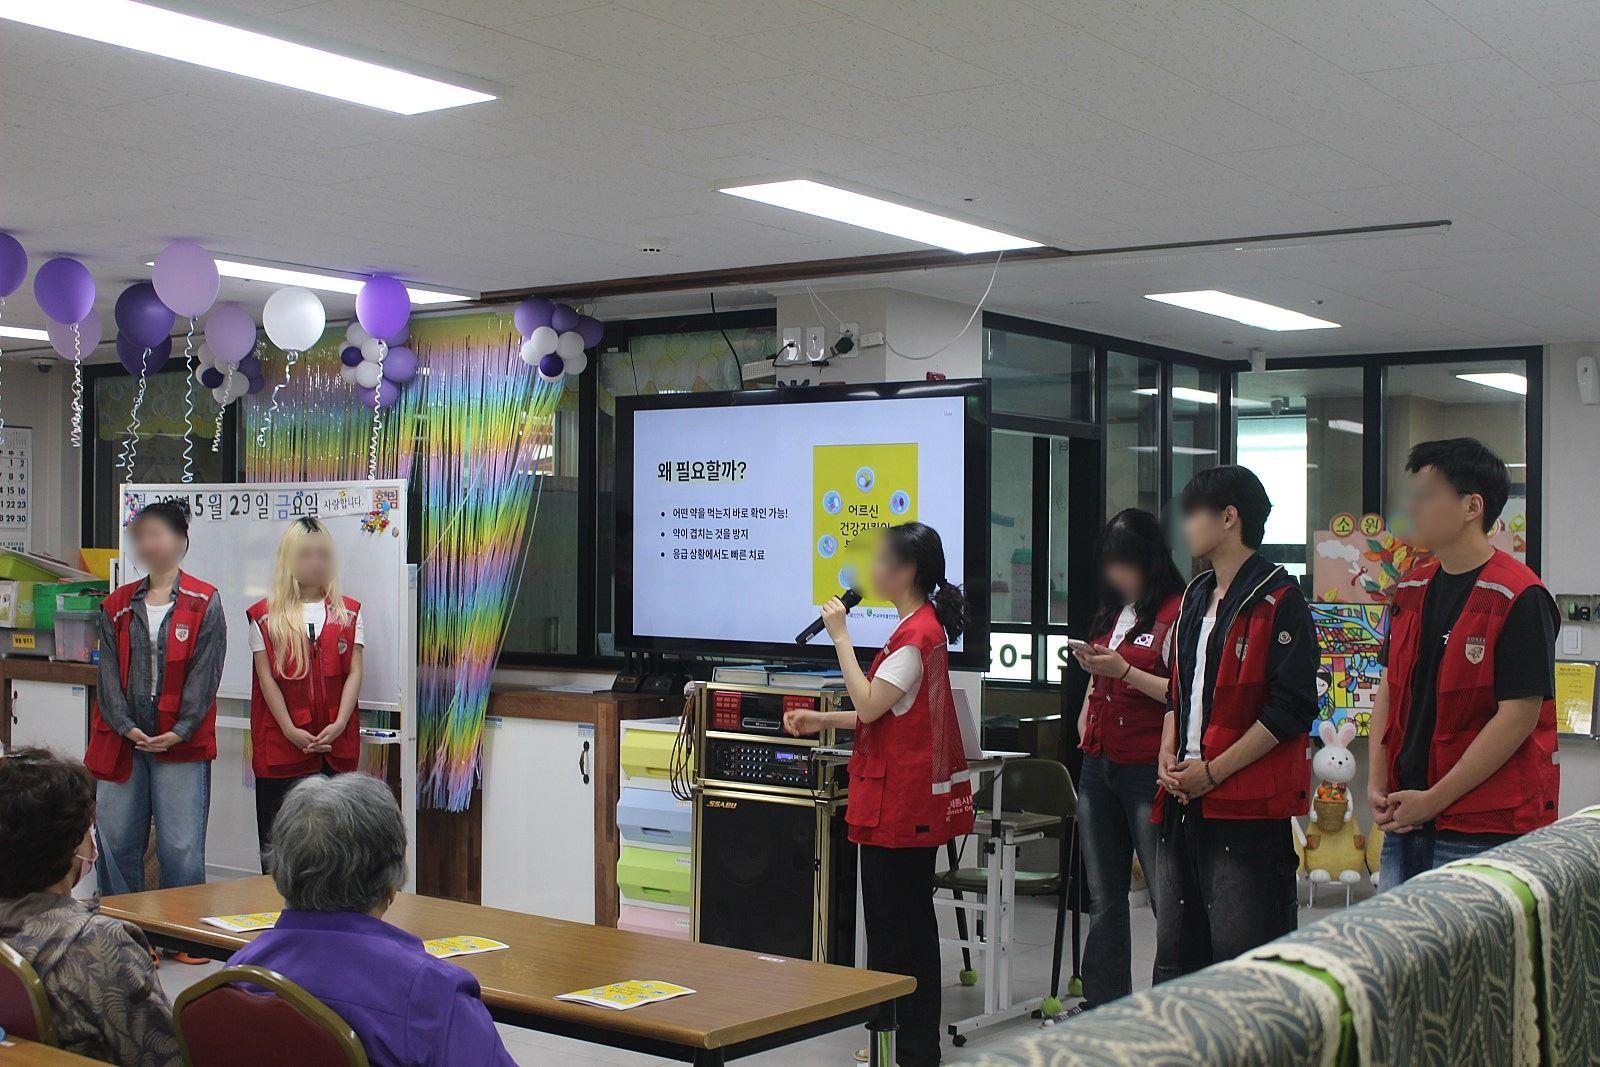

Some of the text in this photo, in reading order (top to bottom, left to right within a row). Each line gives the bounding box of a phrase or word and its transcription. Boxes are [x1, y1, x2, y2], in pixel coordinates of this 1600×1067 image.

[658, 459, 747, 482] 왜 필요할까?
[7, 486, 26, 495] 15 16
[6, 500, 15, 509] 22
[17, 500, 26, 509] 23
[194, 493, 223, 520] 5월
[229, 493, 269, 520] 29일
[274, 491, 319, 520] 금요일
[323, 496, 364, 511] 사랑합니다.
[6, 514, 15, 523] 29
[16, 514, 26, 523] 30
[672, 507, 788, 520] 어떤 약을 먹는지 바로 확인 가능!
[848, 505, 879, 519] 어르신
[672, 527, 749, 541] 약이 겹치는 것을 방지
[672, 548, 765, 561] 응급 상황에서도 빠른 치료
